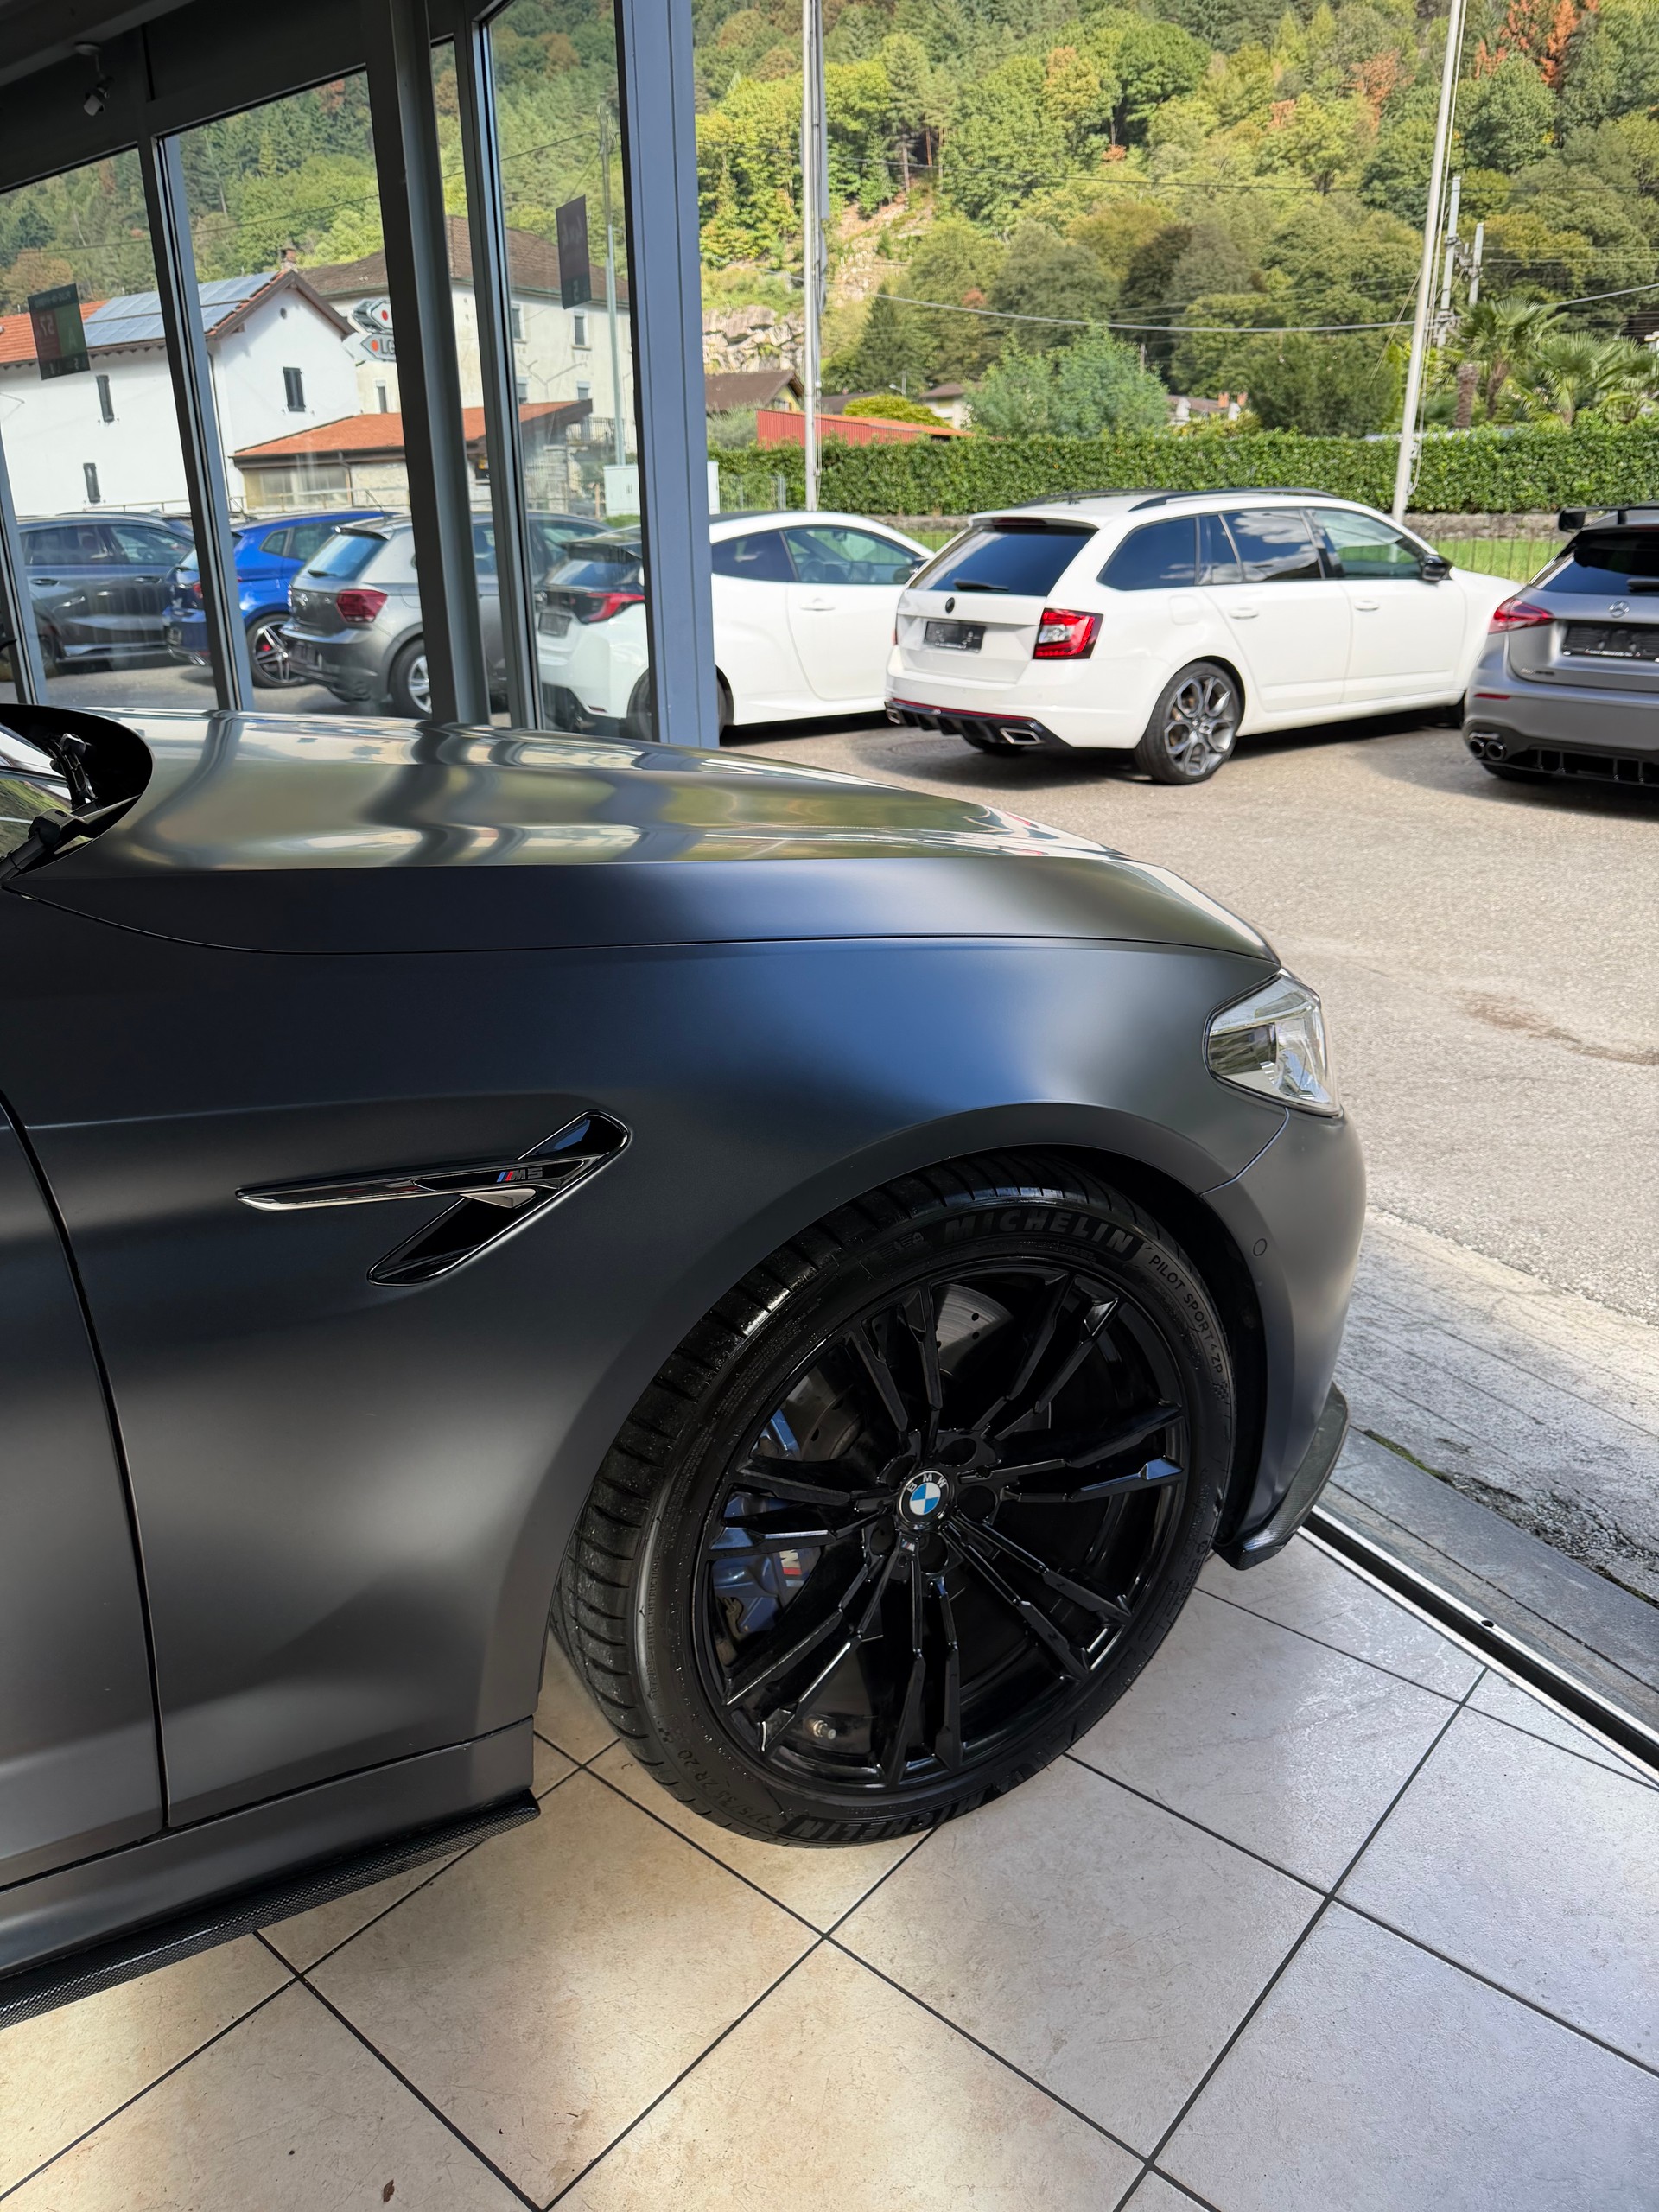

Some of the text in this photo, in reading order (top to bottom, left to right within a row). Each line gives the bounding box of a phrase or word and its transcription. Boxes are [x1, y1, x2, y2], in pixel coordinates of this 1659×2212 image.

[944, 1210, 1134, 1253] MICHELIN
[1148, 1255, 1185, 1291] PILOT
[1183, 1293, 1214, 1341] SPORT
[1209, 1352, 1223, 1373] ZP
[906, 1473, 948, 1493] BMW
[678, 1750, 700, 1767] 20
[790, 1790, 983, 1840] MICHELIN
